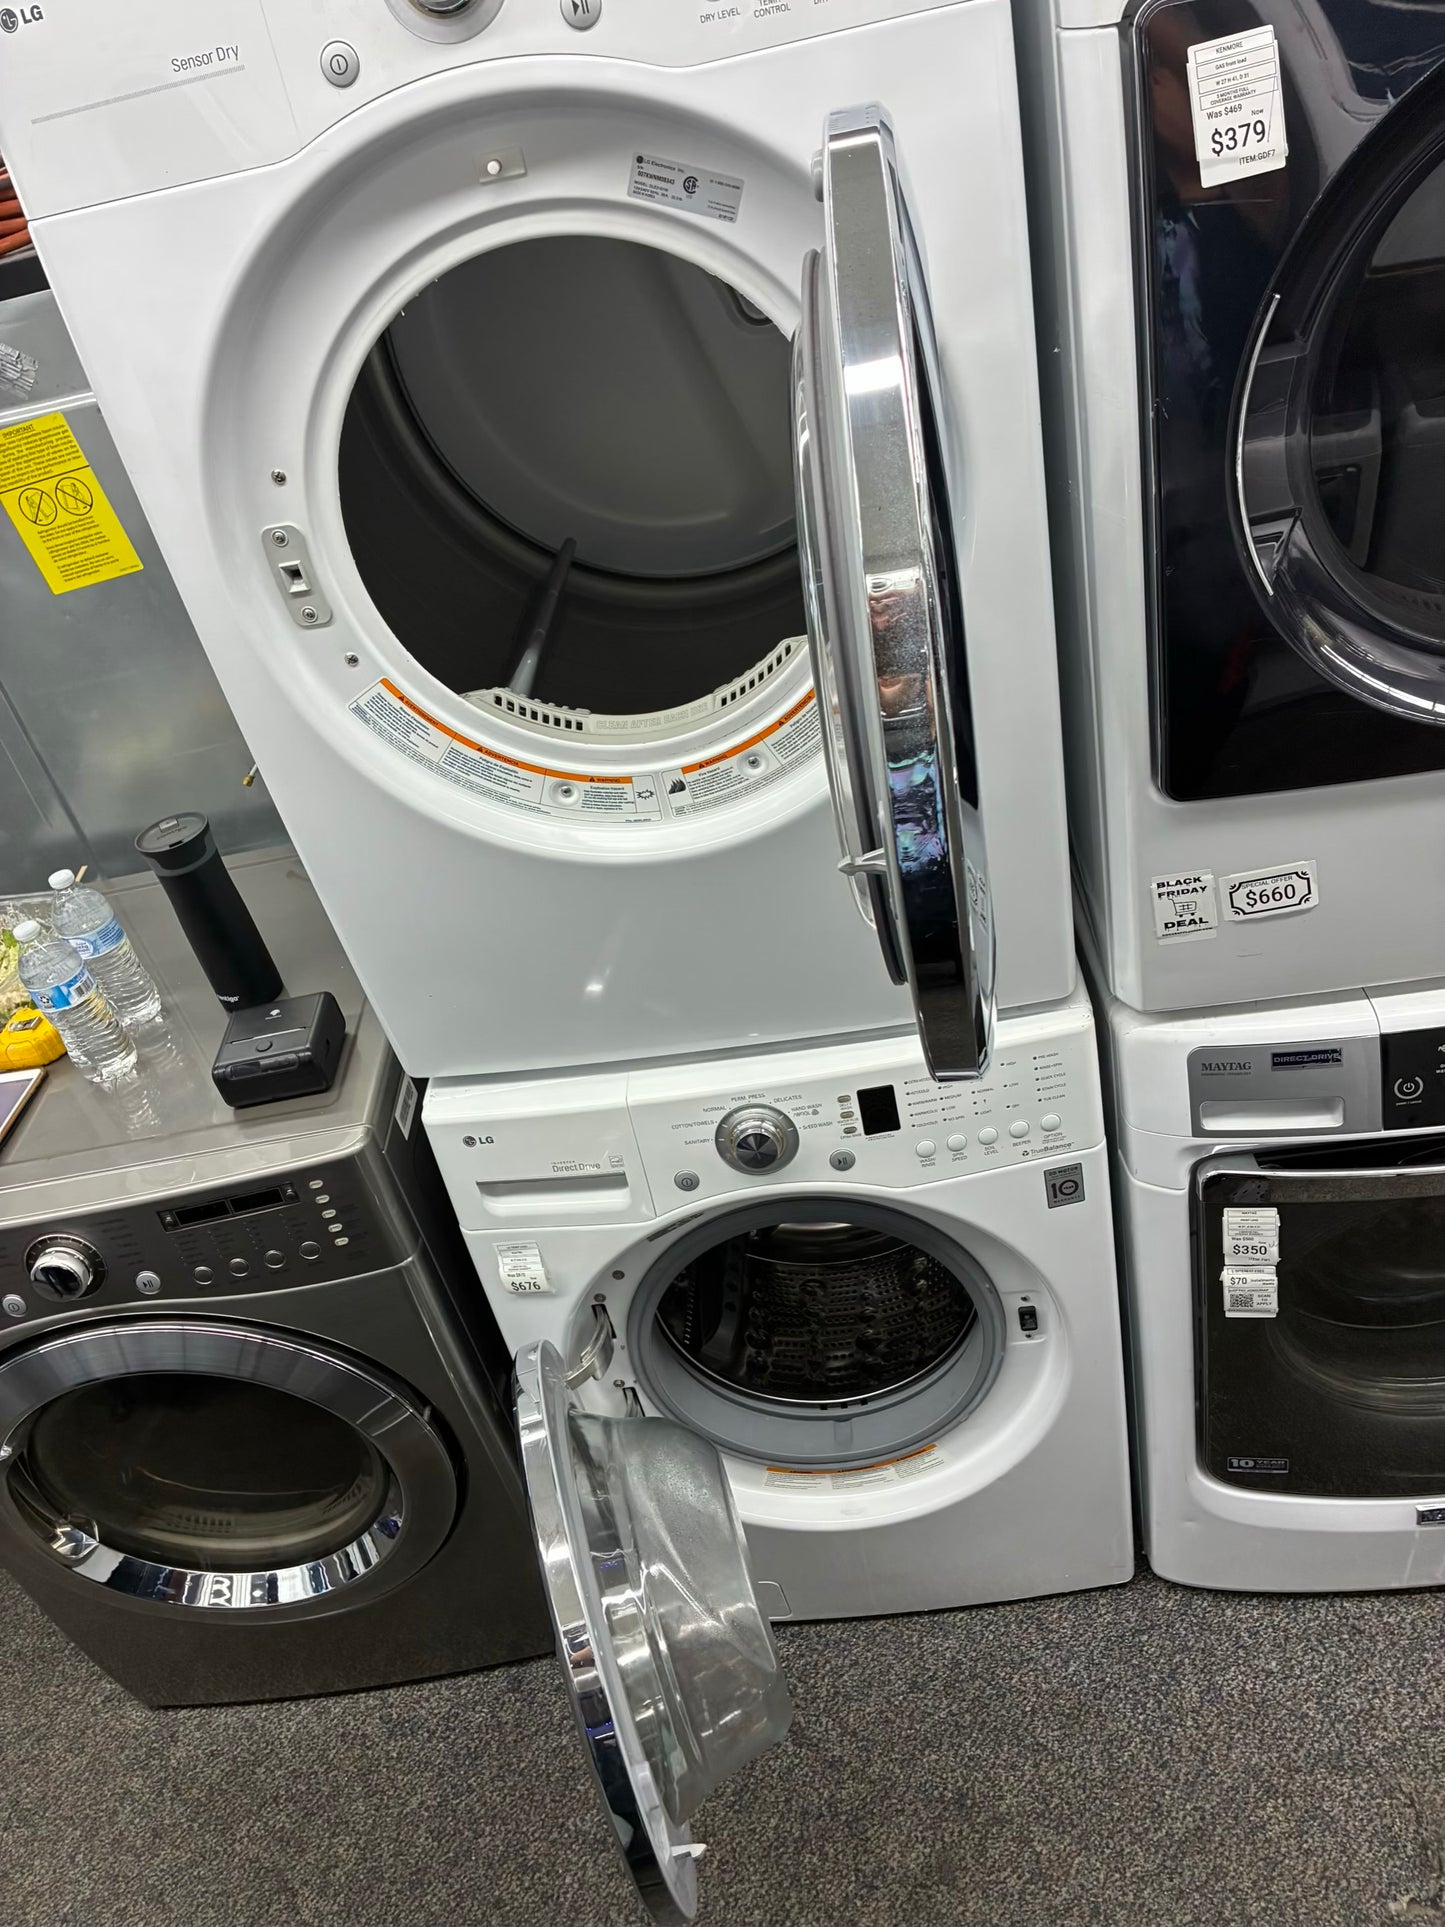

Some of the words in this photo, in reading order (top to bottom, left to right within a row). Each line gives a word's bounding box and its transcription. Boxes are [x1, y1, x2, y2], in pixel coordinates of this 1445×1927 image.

[20, 4, 44, 24] LG
[700, 12, 716, 23] DRY
[717, 7, 741, 19] LEVEL
[754, 3, 791, 18] CONTROL
[1216, 42, 1243, 54] KENMORE
[171, 51, 213, 72] Sensor
[216, 45, 239, 61] Dry
[1233, 89, 1256, 99] WARRANTY
[1206, 110, 1222, 120] Was
[1224, 104, 1242, 116] $469
[1211, 120, 1266, 156] $379
[1156, 876, 1202, 889] BLACK
[1242, 880, 1269, 890] SPECIAL
[1271, 876, 1293, 884] OFFER
[1158, 886, 1208, 898] FRIDAY
[1246, 884, 1296, 908] $660
[1164, 917, 1208, 930] DEAL
[1273, 1055, 1310, 1063] DIRECT
[1201, 1062, 1252, 1072] MAYTAG
[774, 1094, 802, 1104] DELICATES
[672, 1120, 714, 1130] COTTON/TOWELS
[479, 1136, 494, 1145] LG
[552, 1164, 578, 1172] Direct
[578, 1162, 600, 1170] Drive
[1051, 1180, 1079, 1200] 10
[1232, 1244, 1268, 1256] $350
[511, 1282, 541, 1292] $676
[1230, 1276, 1248, 1286] $70
[1230, 1458, 1254, 1468] 10
